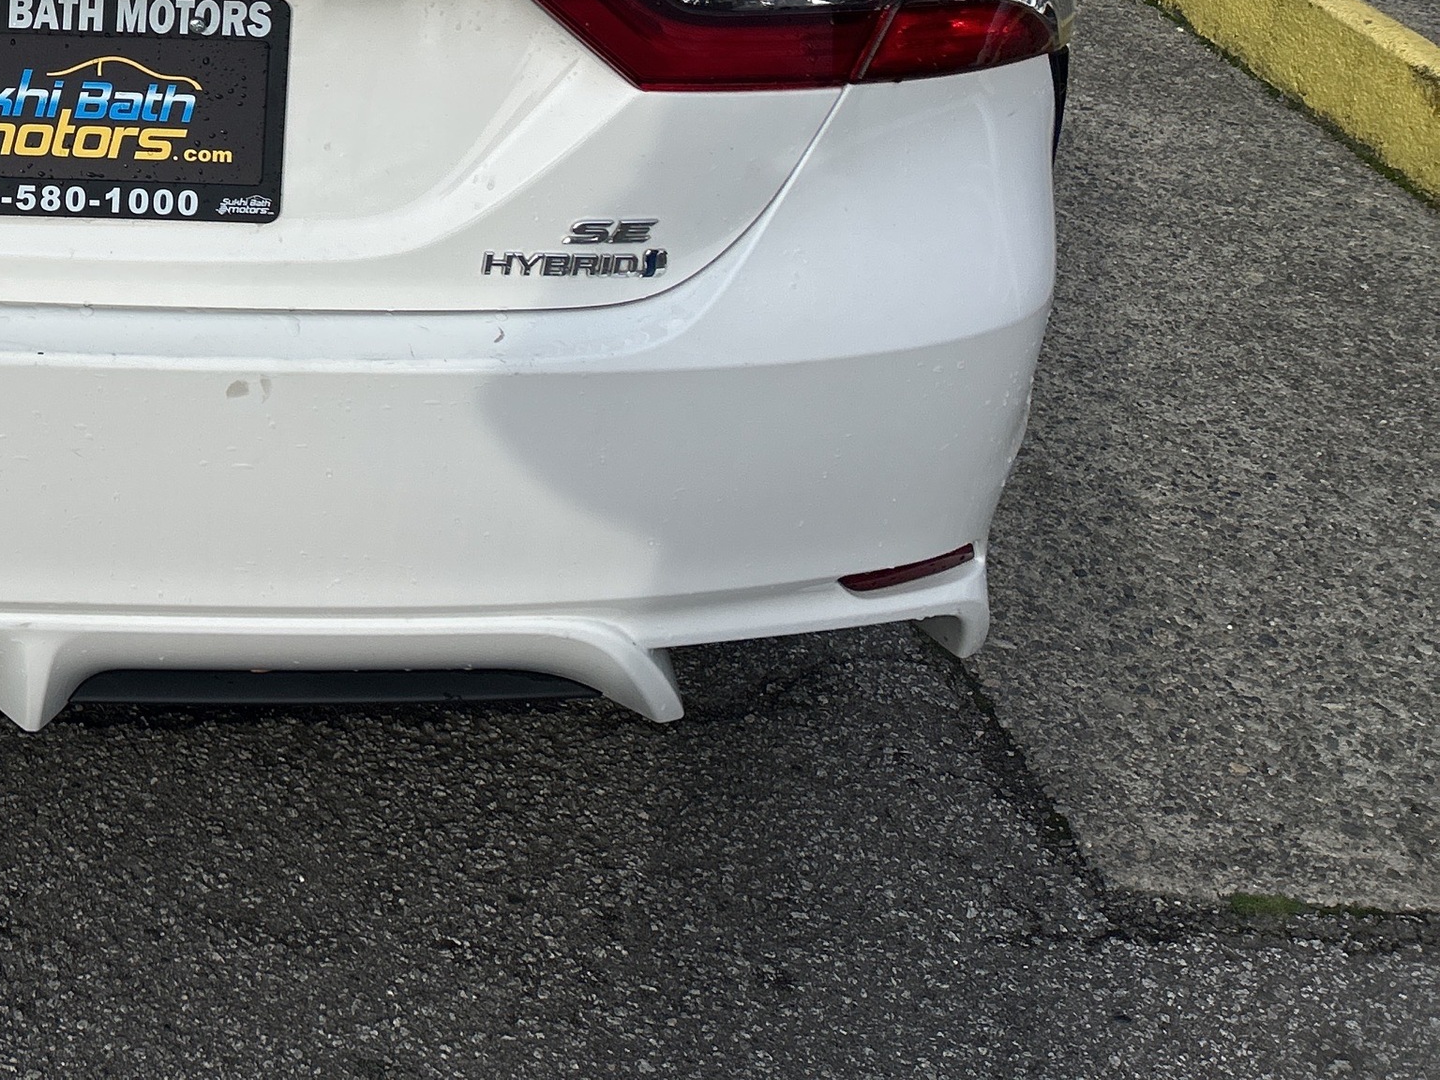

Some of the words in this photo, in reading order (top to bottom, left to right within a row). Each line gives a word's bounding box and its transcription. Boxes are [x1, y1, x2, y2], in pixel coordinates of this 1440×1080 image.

[70, 80, 198, 123] Bath
[561, 219, 659, 245] SE
[480, 251, 639, 278] HYBRID
